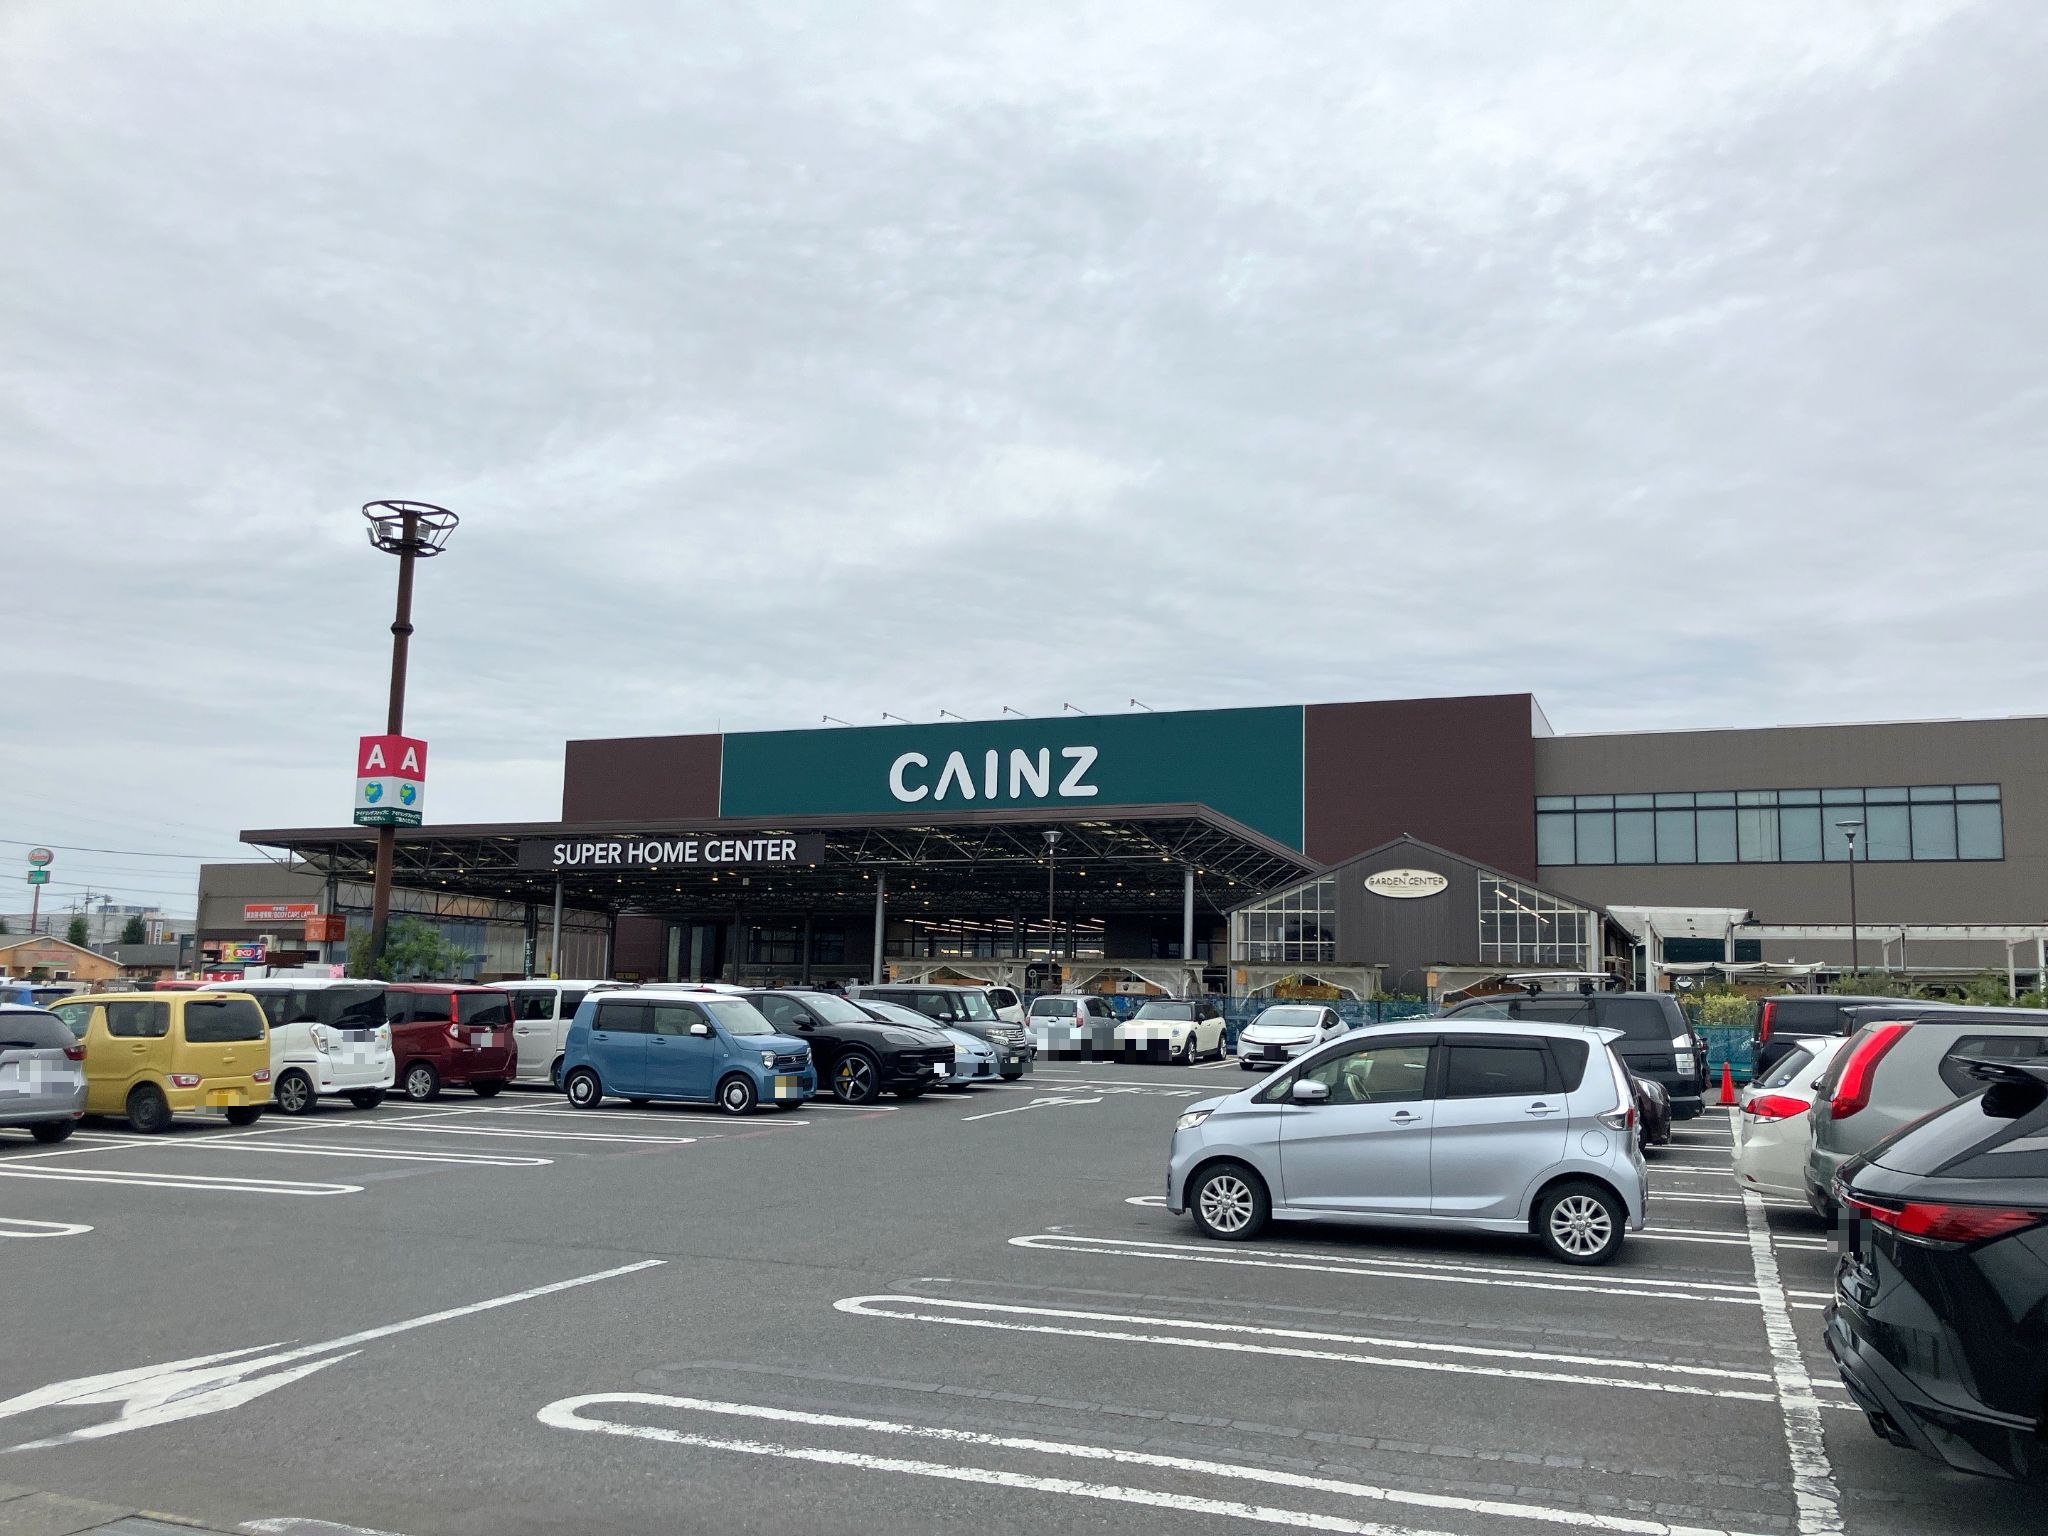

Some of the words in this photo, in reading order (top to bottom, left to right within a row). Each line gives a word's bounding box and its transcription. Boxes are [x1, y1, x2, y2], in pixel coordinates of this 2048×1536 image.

[366, 744, 386, 770] A
[400, 747, 419, 772] A
[889, 746, 1099, 802] CAINZ
[553, 843, 622, 865] SUPER
[627, 841, 698, 864] HOME
[705, 839, 797, 862] CENTER
[1369, 877, 1406, 885] GARDEN
[1408, 877, 1444, 885] CENTER
